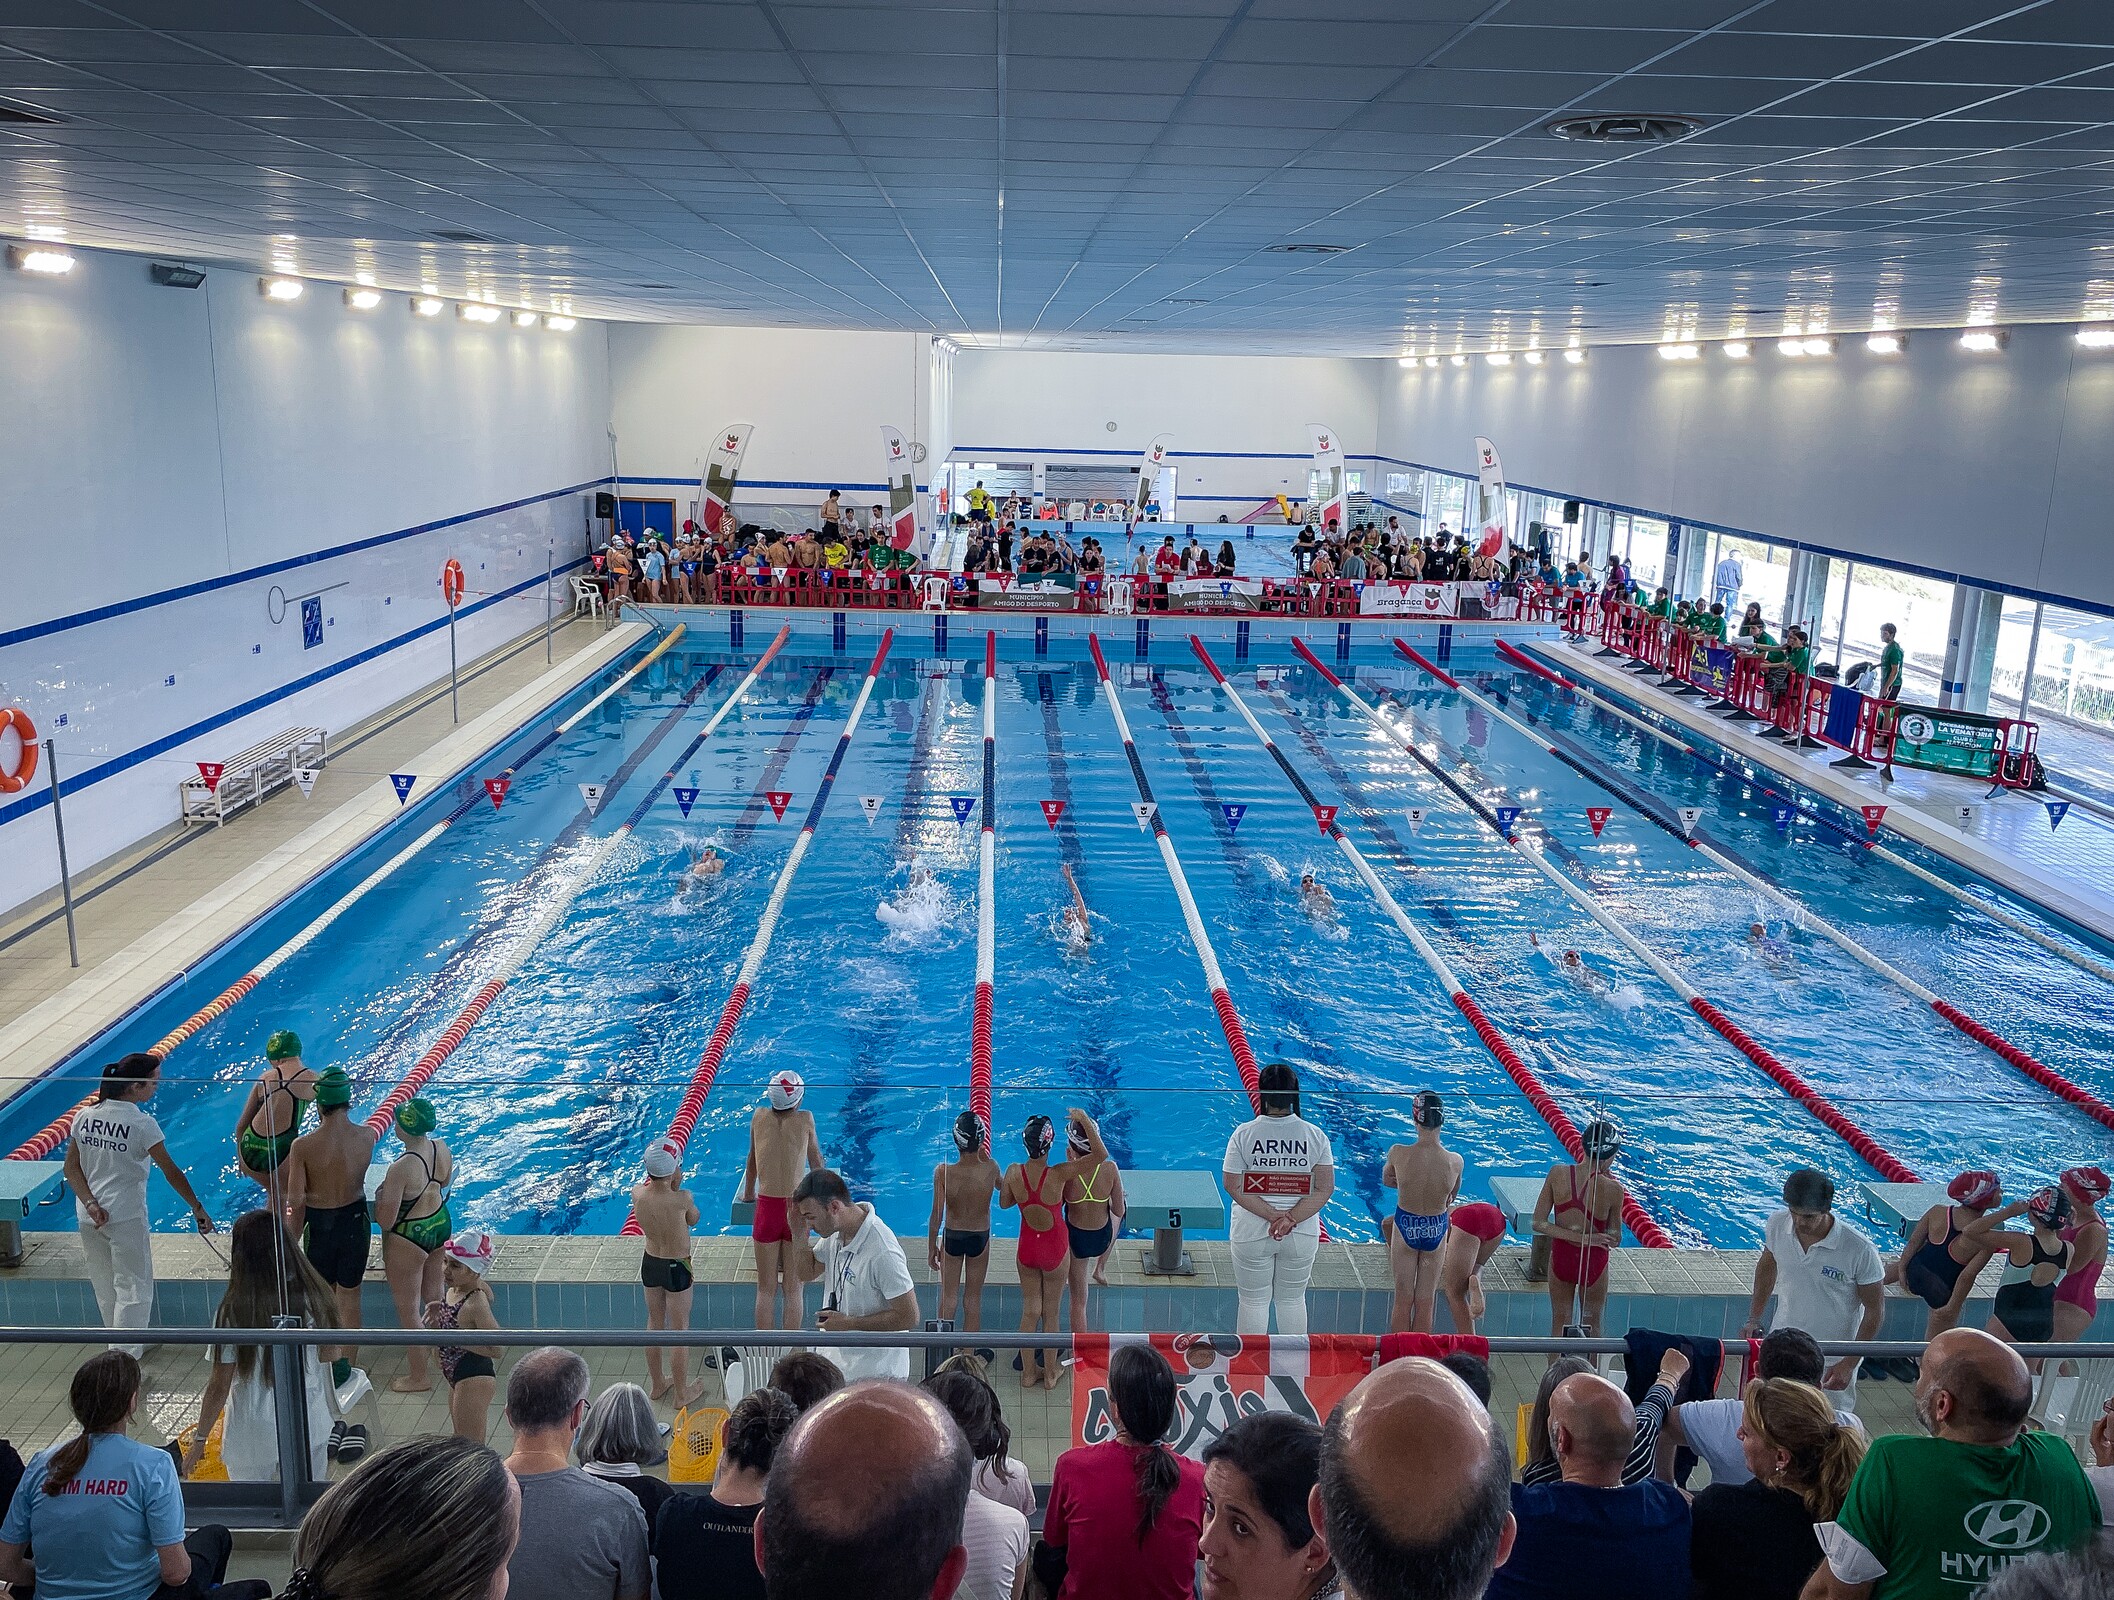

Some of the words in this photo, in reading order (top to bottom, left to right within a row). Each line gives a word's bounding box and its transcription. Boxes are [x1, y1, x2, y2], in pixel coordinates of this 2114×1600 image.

[1950, 727, 1993, 738] VENATORIA
[1953, 735, 1969, 743] CLUB
[80, 1117, 131, 1140] ARNN
[1251, 1139, 1308, 1155] ARNN
[1252, 1155, 1308, 1167] ÁRBITRO
[21, 1196, 30, 1217] 8
[1169, 1208, 1182, 1228] 5
[1899, 1217, 1907, 1239] 3
[84, 1479, 128, 1496] HARD
[702, 1522, 754, 1534] OUTLANDER
